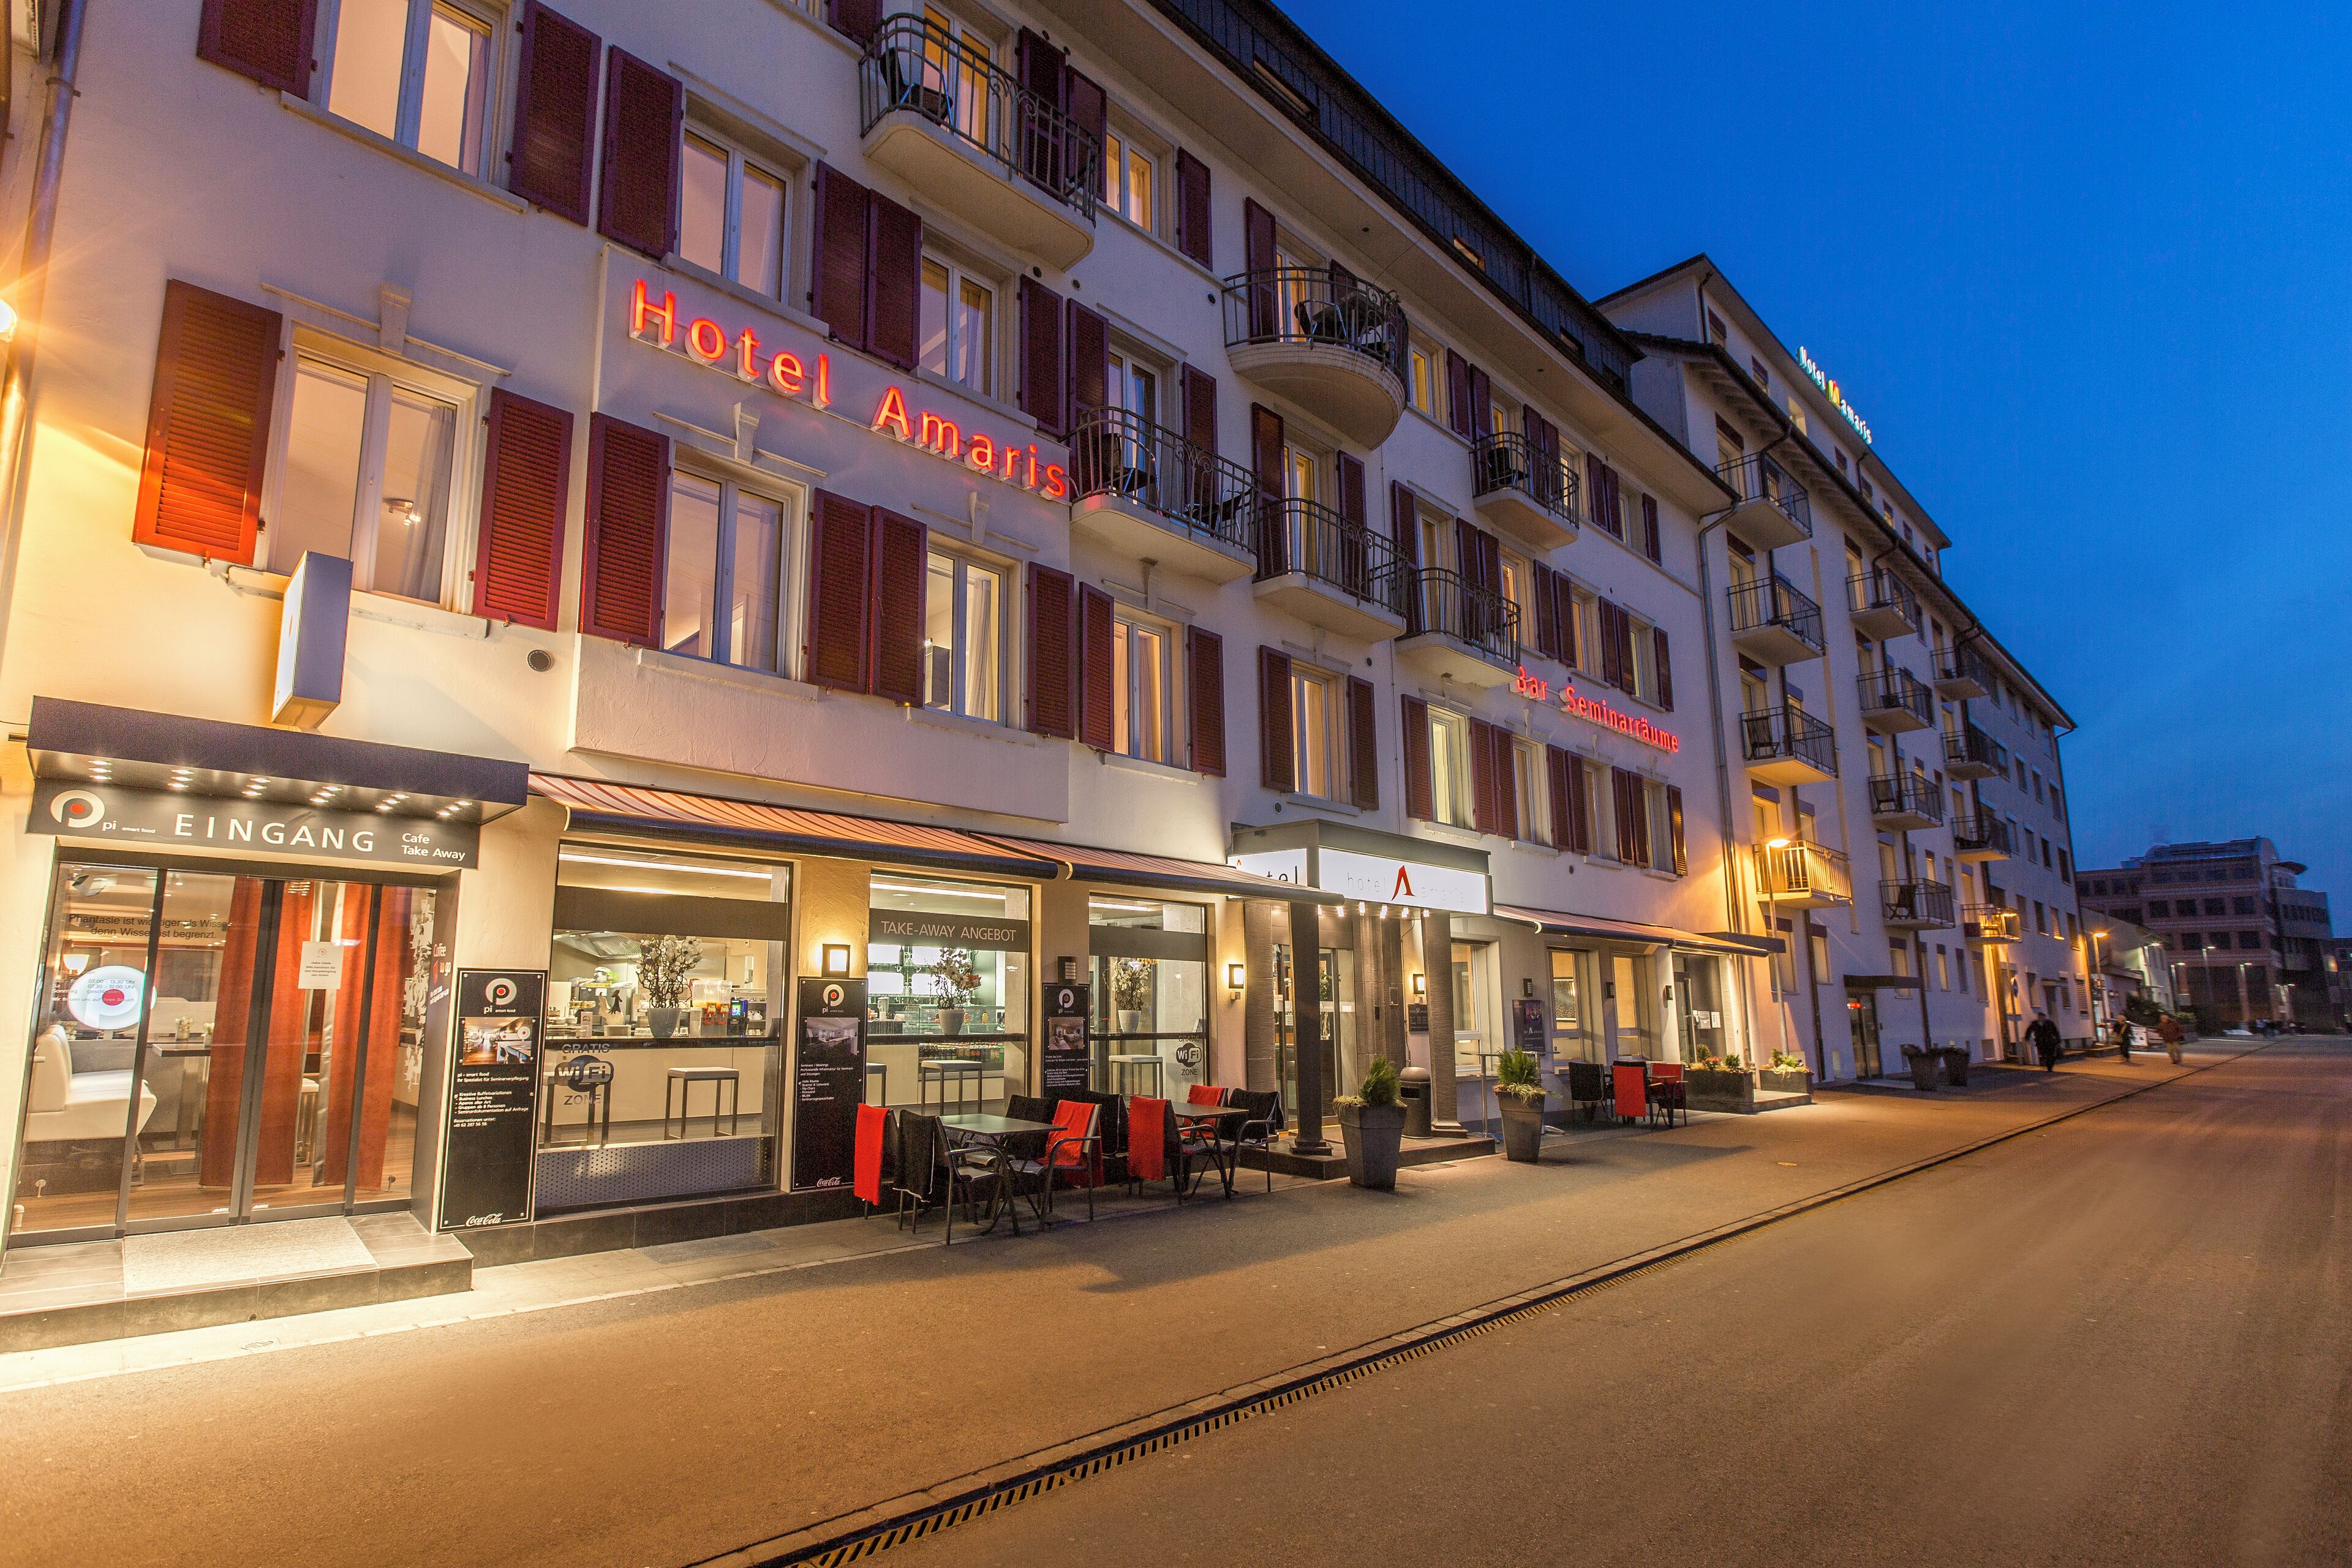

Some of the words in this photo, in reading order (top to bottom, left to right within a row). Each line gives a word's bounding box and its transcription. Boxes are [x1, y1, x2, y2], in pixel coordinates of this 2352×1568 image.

[634, 279, 831, 406] Hotel
[875, 386, 1068, 499] Amaris
[1516, 665, 1547, 700] Bar
[1565, 685, 1679, 753] Seminarräume
[102, 821, 117, 831] pi
[175, 813, 374, 852] EINGANG
[402, 832, 430, 844] Cafe
[401, 845, 429, 857] Take
[432, 848, 466, 861] Away
[1347, 872, 1386, 892] hotel
[69, 914, 120, 924] Phantasie
[200, 919, 227, 928] Wisse
[91, 927, 116, 935] denn
[120, 928, 151, 937] Wisse
[173, 930, 216, 939] begrenzt.
[881, 921, 956, 938] TAKE-AWAY
[960, 926, 1016, 941] ANGEBOT
[445, 962, 451, 976] go
[484, 1005, 492, 1014] pi
[562, 1043, 610, 1054] GRATIS
[564, 1094, 601, 1105] ZONE
[466, 1213, 503, 1226] Coca-Cola
